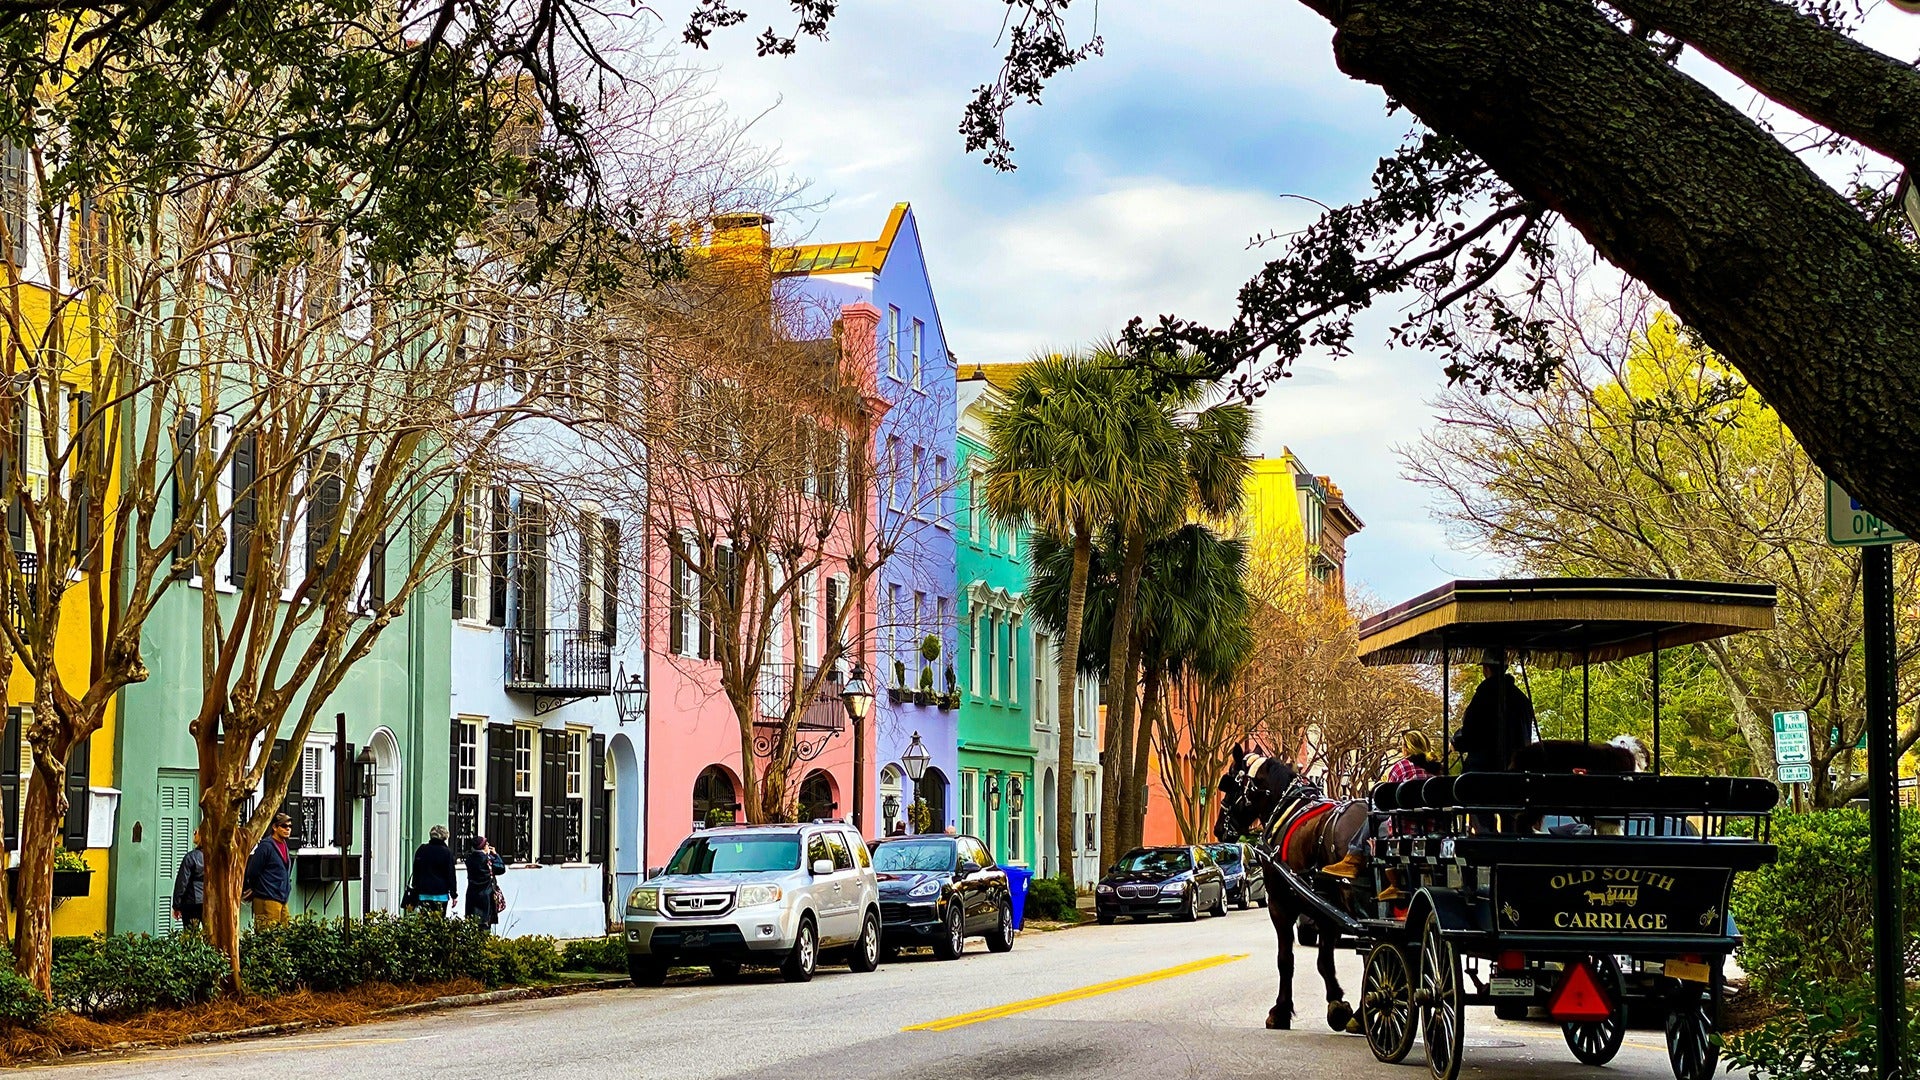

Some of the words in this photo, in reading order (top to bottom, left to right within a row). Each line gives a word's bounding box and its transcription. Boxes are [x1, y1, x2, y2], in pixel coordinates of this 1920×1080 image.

[1853, 514, 1896, 534] ONL
[1778, 717, 1783, 729] 1
[1780, 745, 1799, 753] DISTRICT
[1550, 869, 1596, 890] OLD
[1602, 868, 1676, 891] SOUTH
[1554, 911, 1668, 930] CARRIAGE
[1514, 978, 1533, 988] 338
